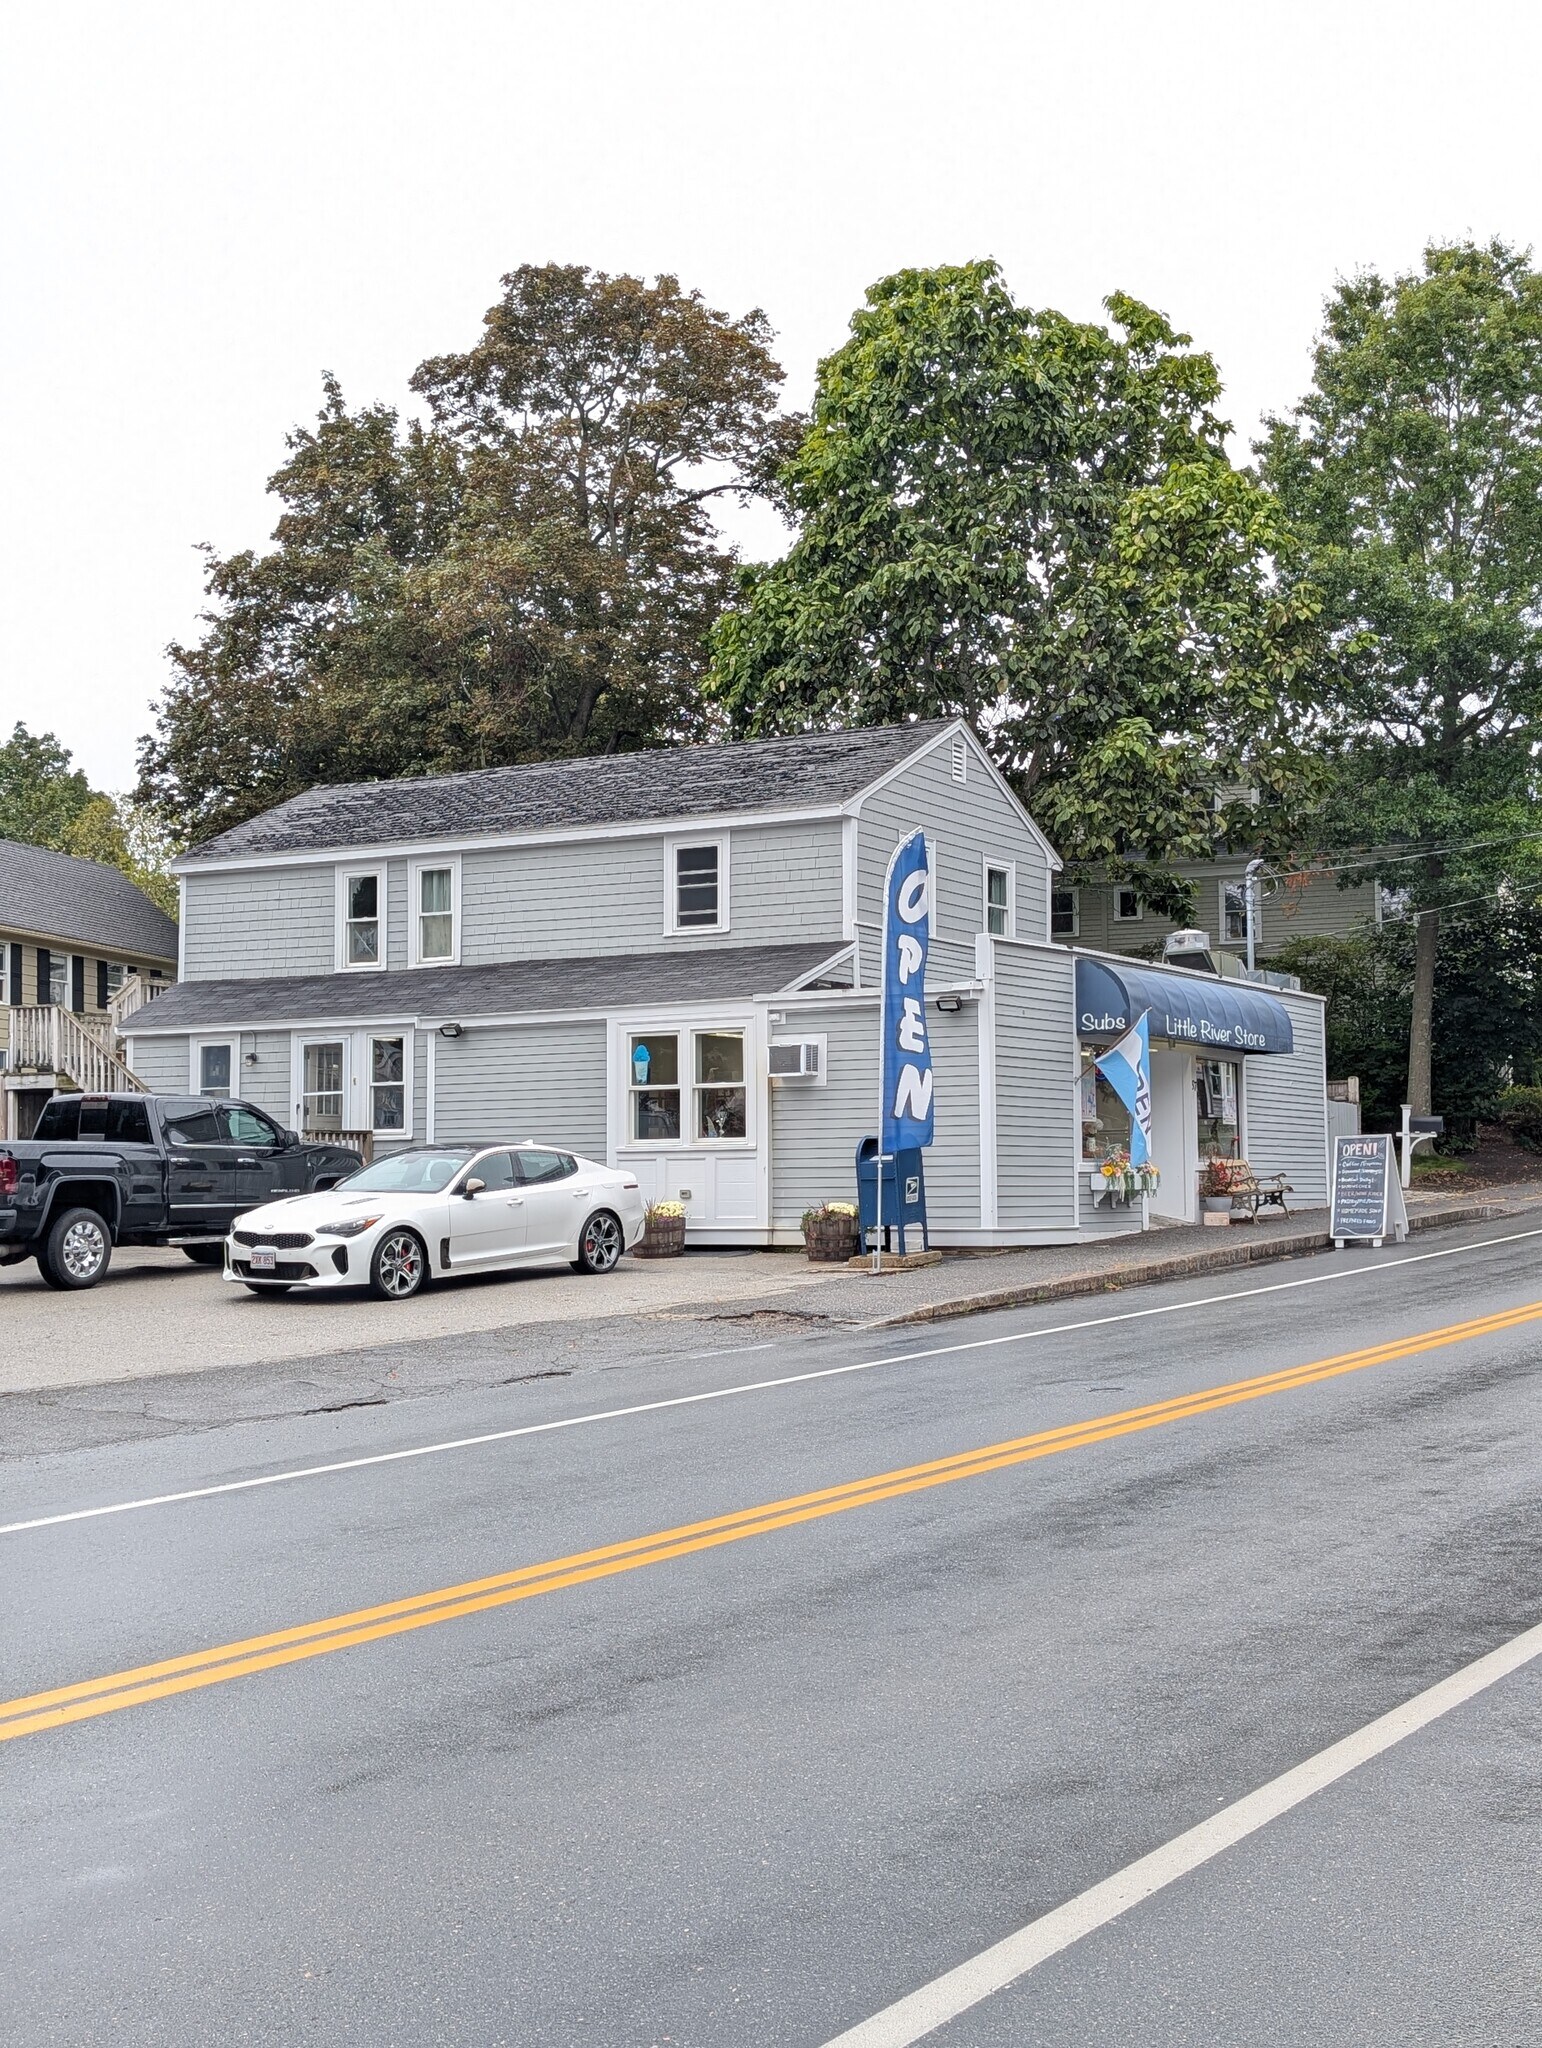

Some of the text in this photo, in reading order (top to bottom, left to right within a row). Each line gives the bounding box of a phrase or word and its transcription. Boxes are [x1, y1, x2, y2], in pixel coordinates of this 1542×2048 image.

[894, 869, 933, 1121] OPEN
[1081, 1012, 1126, 1031] Subs
[1165, 1014, 1266, 1047] Little River Store
[1342, 1142, 1378, 1156] OPEN!
